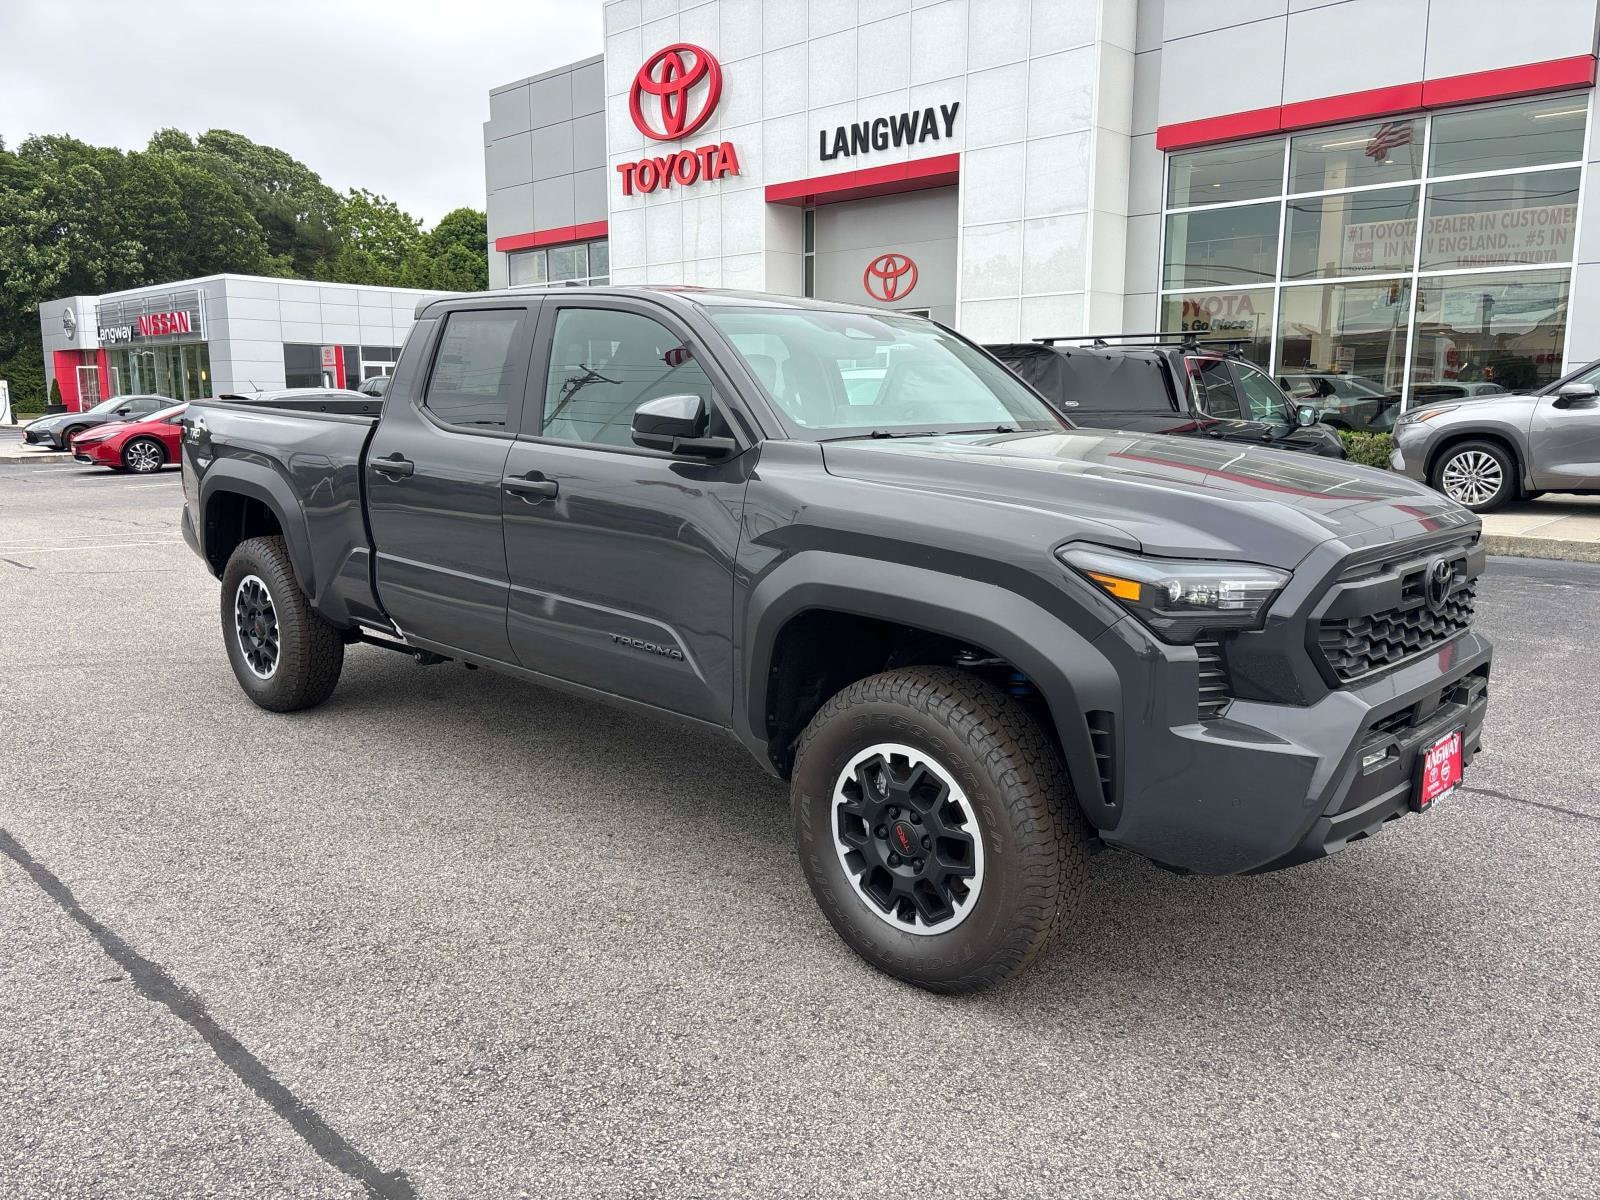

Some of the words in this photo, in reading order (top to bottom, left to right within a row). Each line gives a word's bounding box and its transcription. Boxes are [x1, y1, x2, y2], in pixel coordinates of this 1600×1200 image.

[820, 102, 959, 161] LANGWAY
[617, 142, 740, 196] TOYOTA
[1347, 226, 1363, 242] #1
[1480, 213, 1496, 230] IN
[1383, 241, 1399, 257] IN
[1525, 229, 1545, 247] #5
[1551, 228, 1567, 245] IN
[1457, 253, 1510, 267] LANGWAY
[1514, 249, 1557, 263] TOYOTA
[97, 325, 133, 343] Langway
[137, 311, 191, 336] NISSAN
[1192, 320, 1209, 331] Go
[609, 632, 684, 661] TACOMA
[1424, 733, 1460, 773] ANGWAY
[896, 824, 910, 852] TRD
